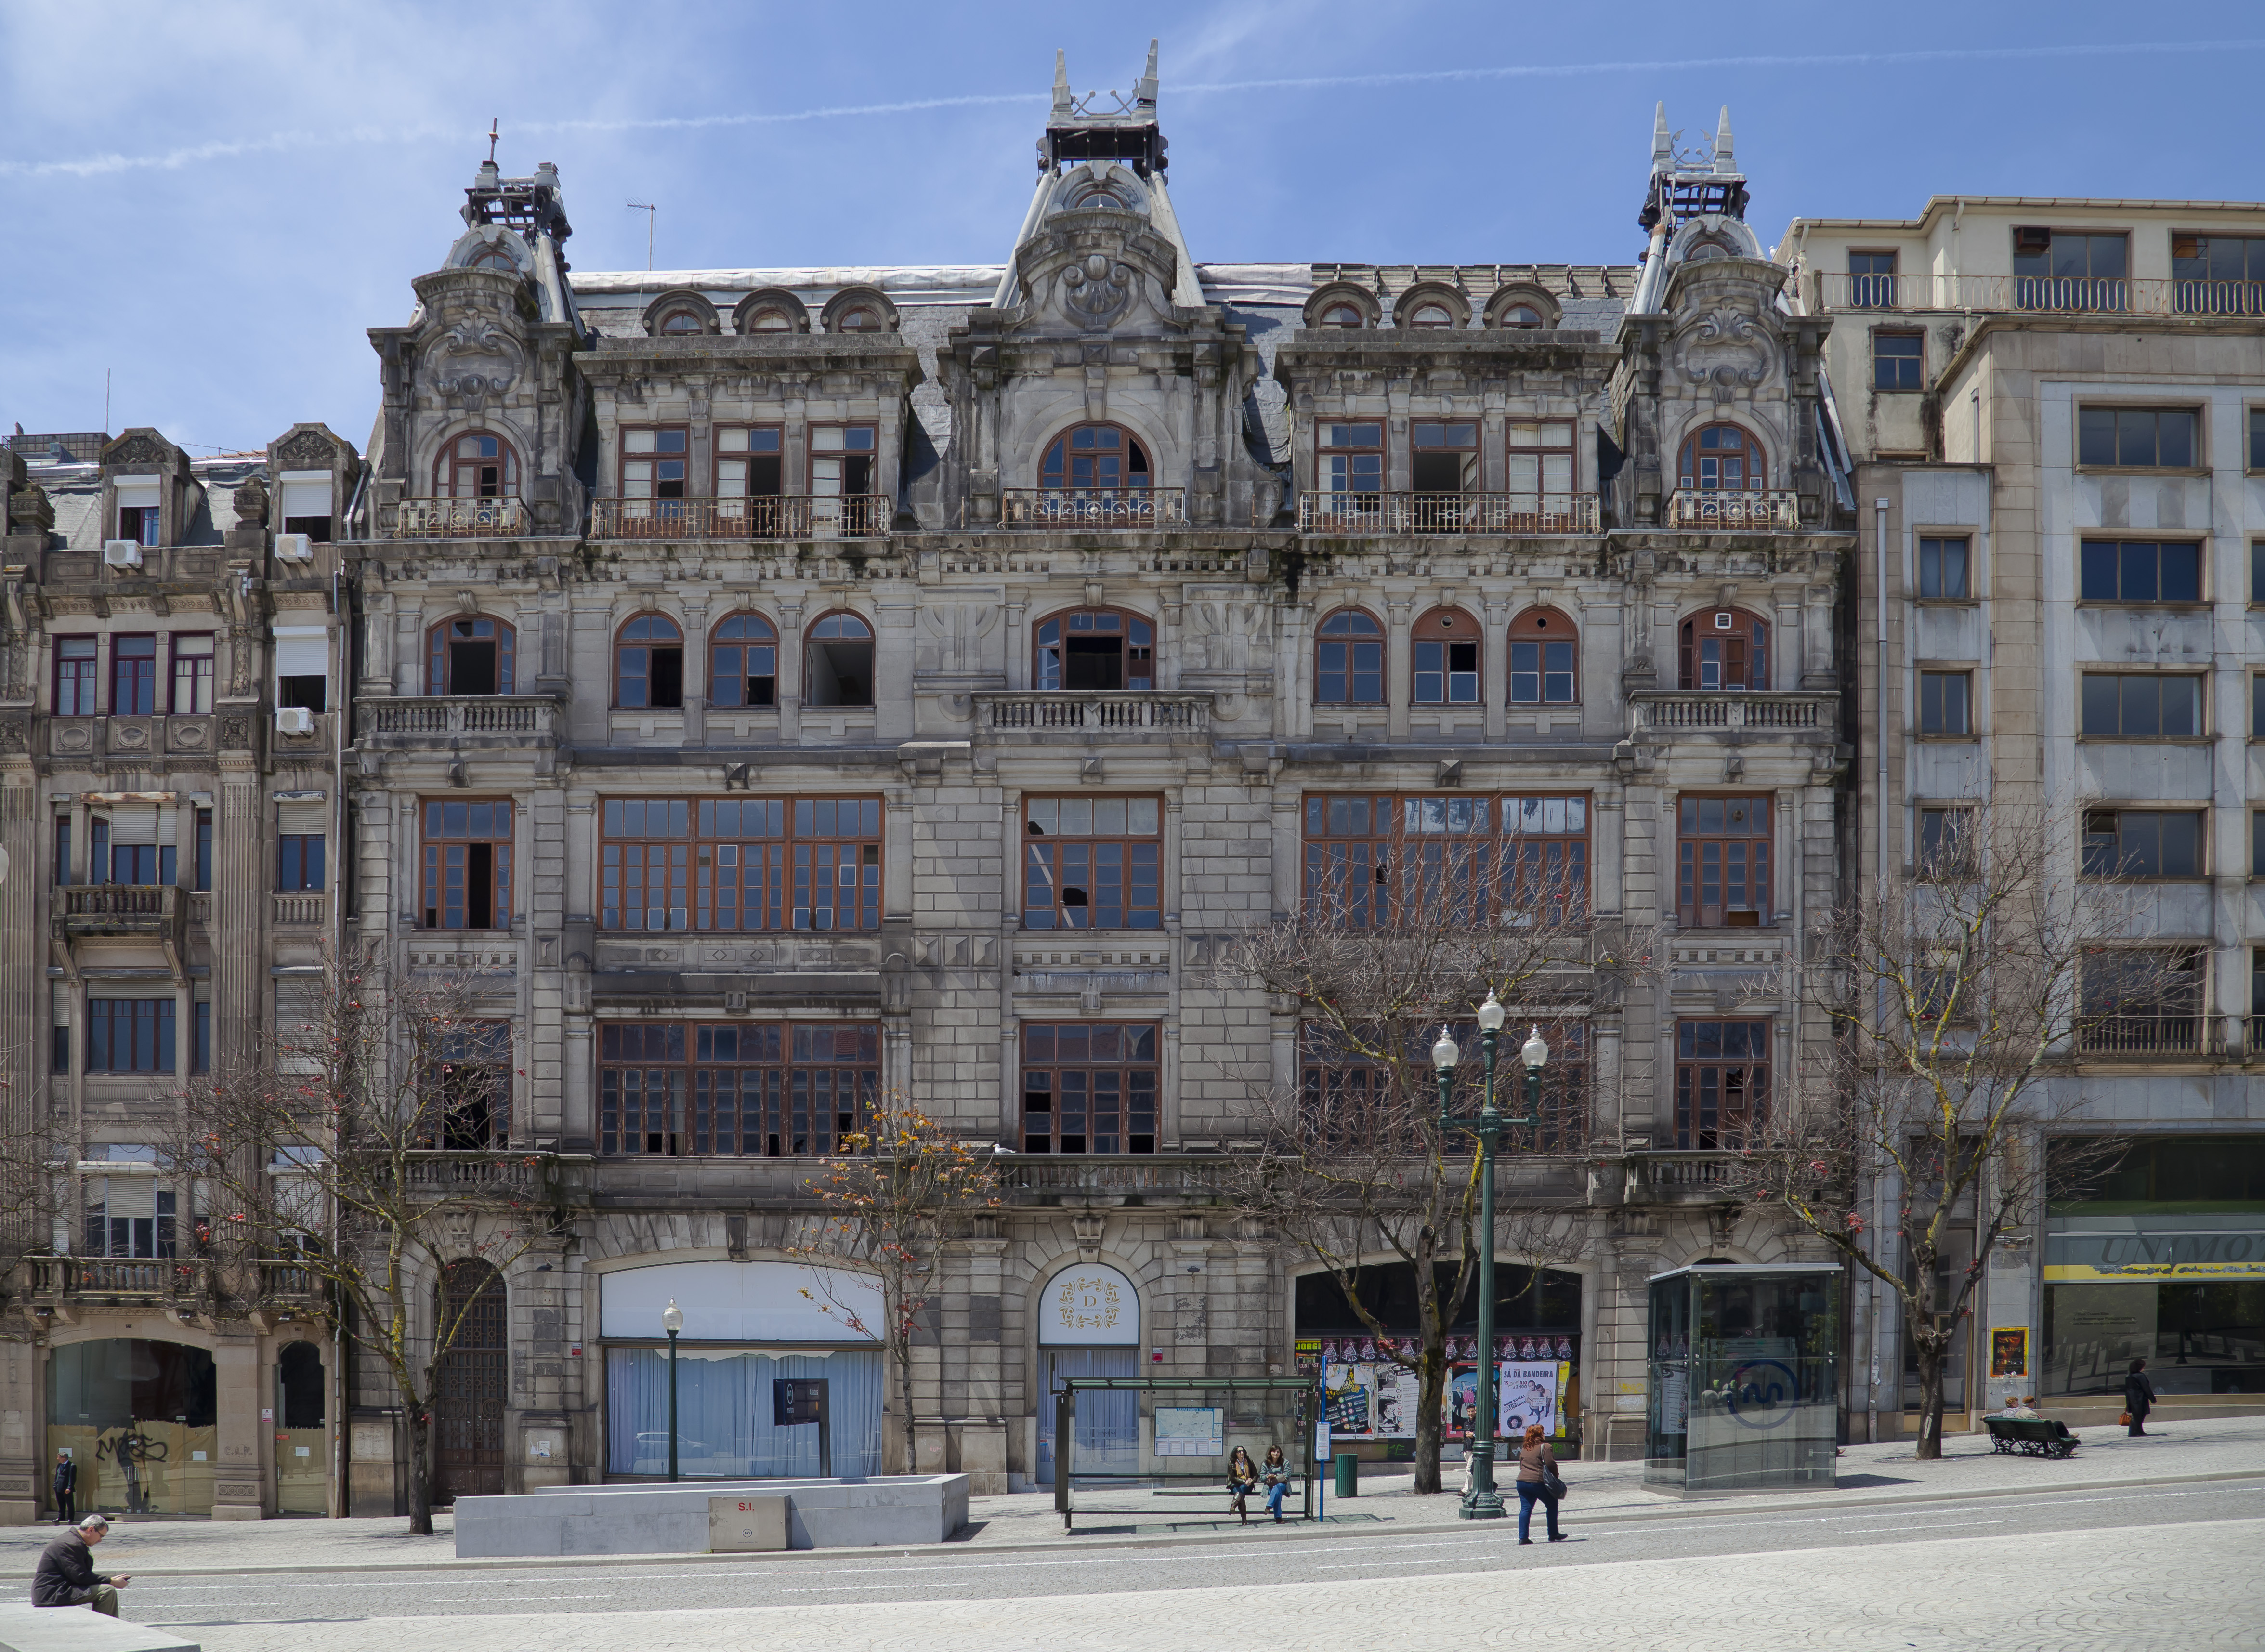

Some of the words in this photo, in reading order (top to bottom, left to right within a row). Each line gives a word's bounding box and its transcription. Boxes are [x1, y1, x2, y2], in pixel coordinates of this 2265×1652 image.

[1083, 1296, 1097, 1307] D
[1504, 1368, 1511, 1378] SÁ
[1513, 1394, 1525, 1403] ROSCAS
[738, 1502, 755, 1511] S.I.
